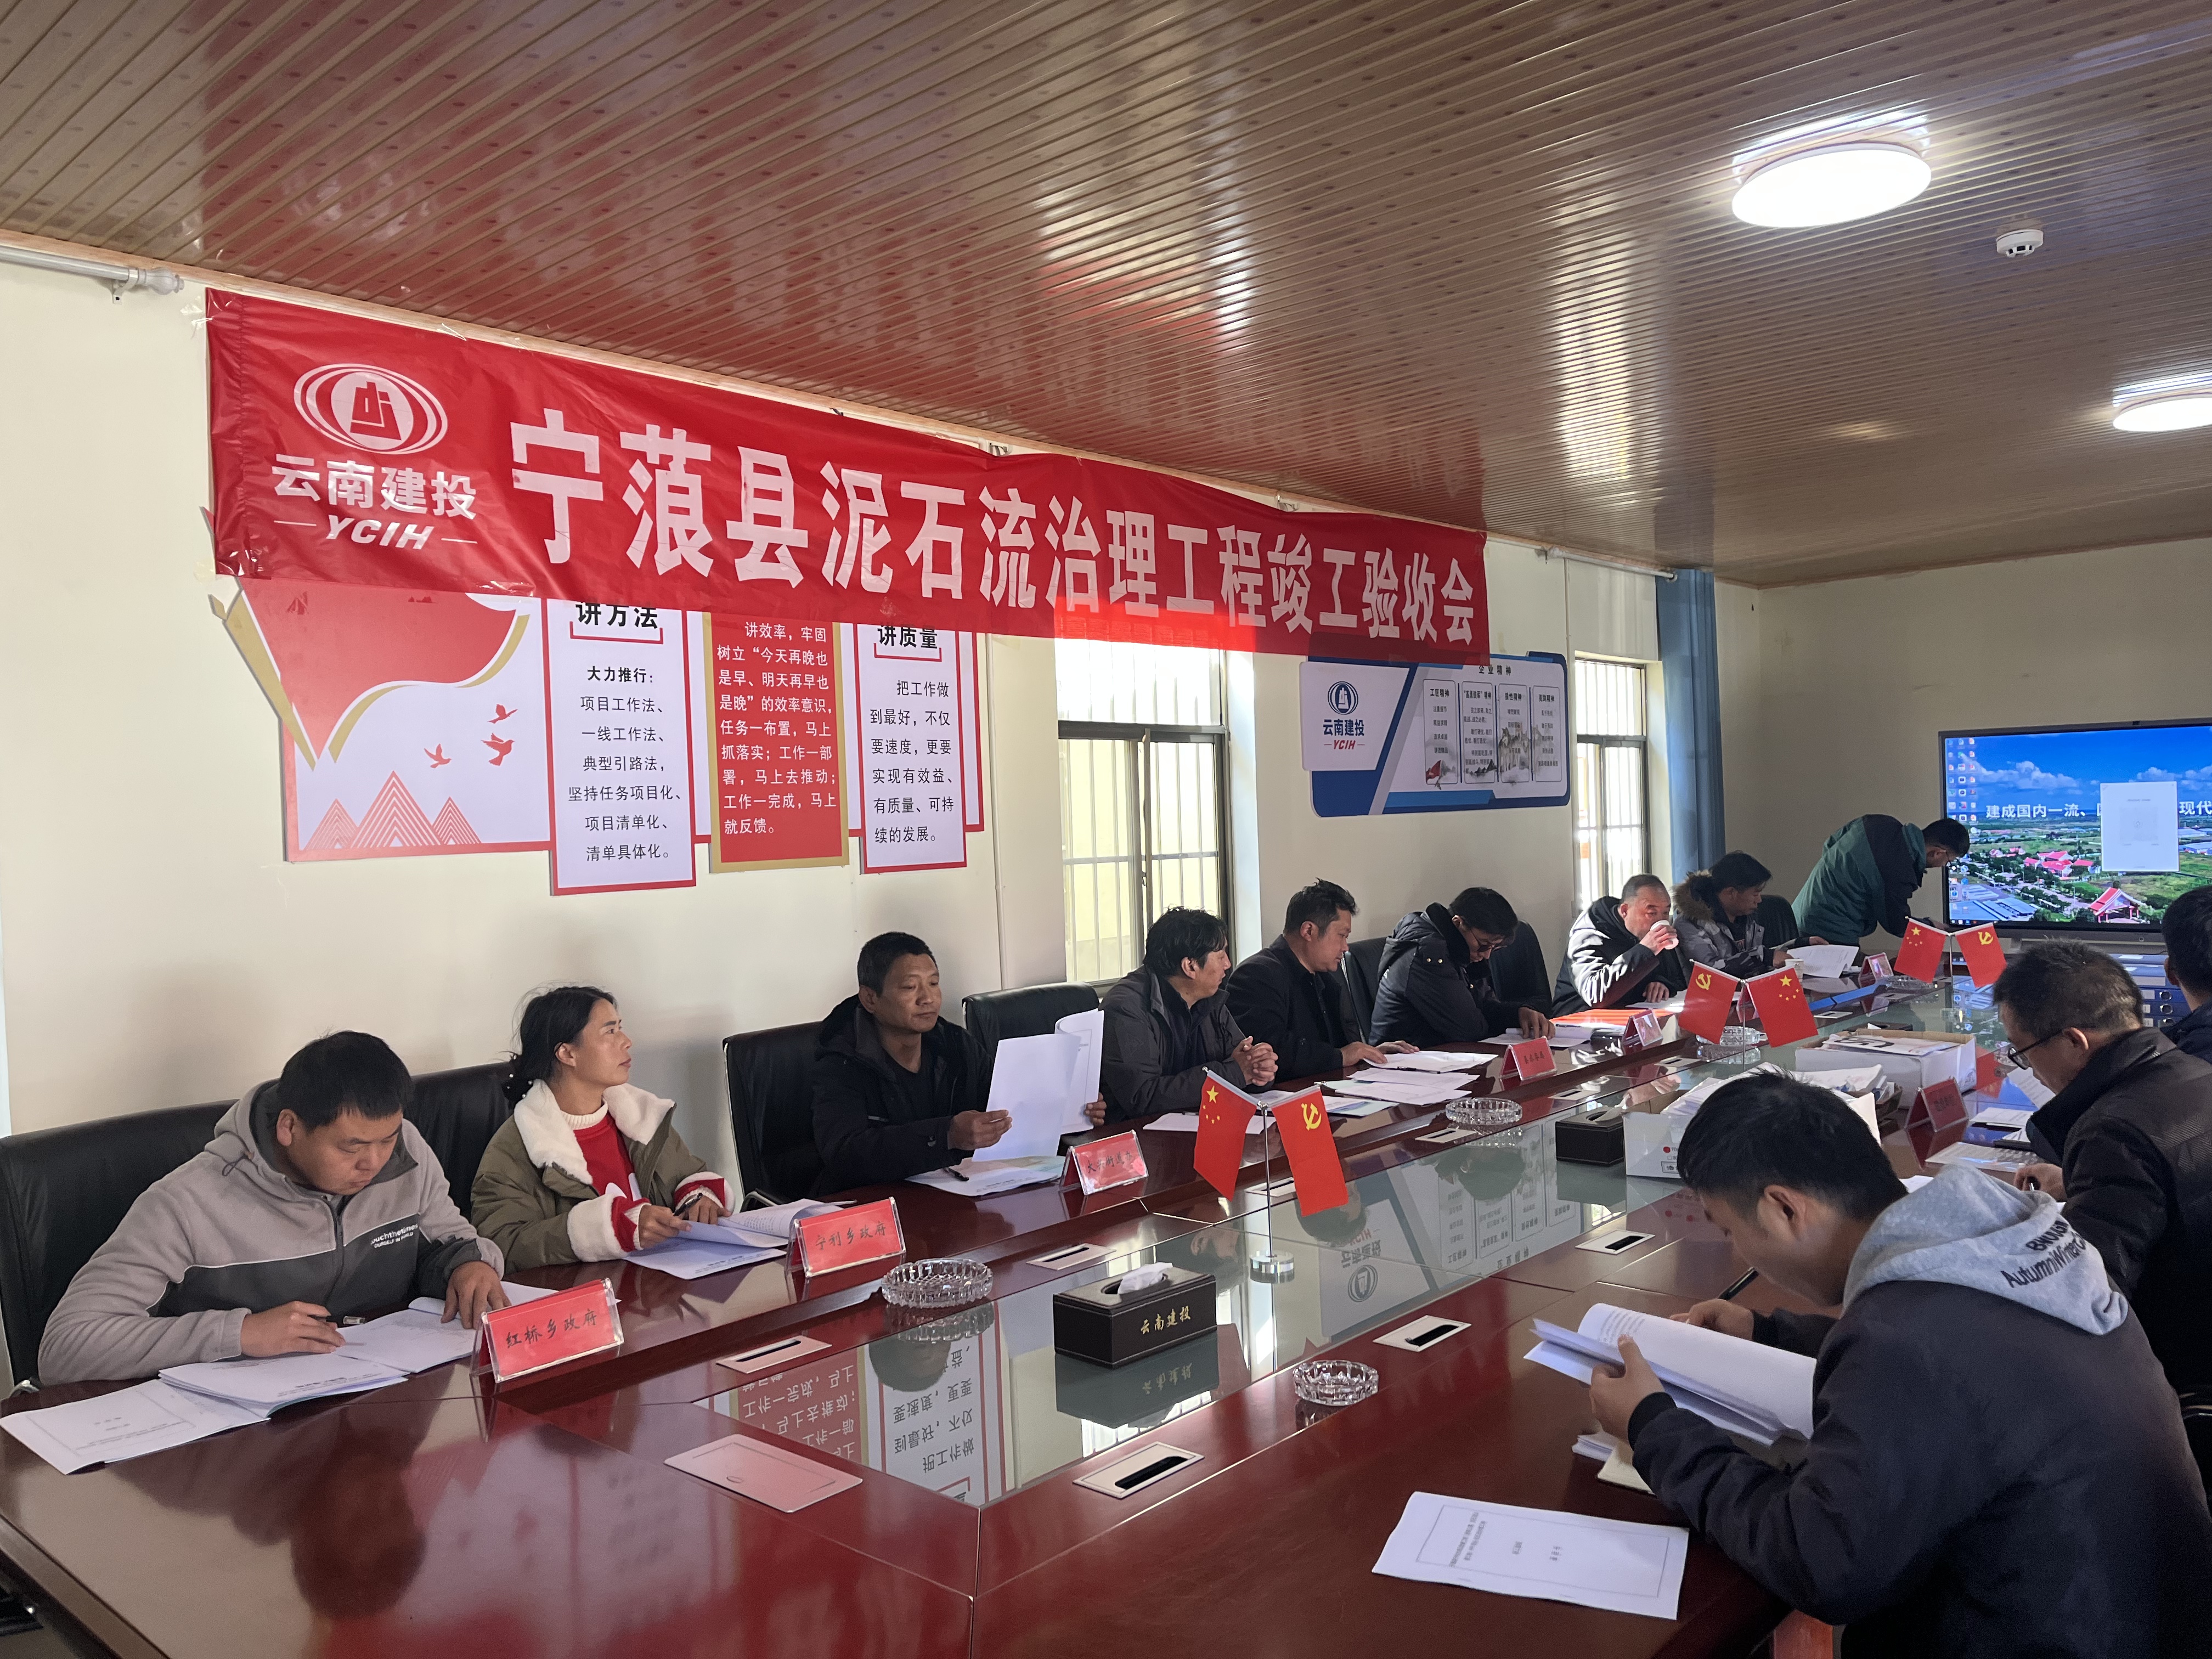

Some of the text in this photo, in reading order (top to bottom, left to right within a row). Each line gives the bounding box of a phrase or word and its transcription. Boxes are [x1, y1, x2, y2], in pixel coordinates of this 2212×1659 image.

[272, 453, 477, 520] 云南建投
[325, 514, 435, 550] YCIH
[510, 408, 1475, 646] 宁蒗县泥石流治理工程竣工验收会
[744, 622, 826, 643] 讲效率，牢固
[717, 644, 828, 666] 树立“今天再晚也
[587, 665, 653, 683] 大力推行：
[718, 669, 829, 690] 是早、明天再早也
[896, 680, 949, 698] 把工作做
[580, 696, 663, 713] 项目工作法、
[719, 694, 831, 714] 是晚”的效率意识，
[870, 709, 950, 726] 到最好，不仅
[582, 726, 663, 742] 一线工作法、
[720, 719, 831, 737] 任务一布置，马上
[1323, 719, 1365, 737] 云南建投
[721, 744, 832, 761] 抓落实；工作一部
[871, 738, 951, 755] 要速度，更要
[1333, 740, 1356, 751] YCIH
[723, 769, 835, 786] 署，马上去推动；
[873, 768, 952, 784] 实现有效益、
[568, 785, 681, 802] 坚持任务项目化、
[724, 792, 837, 809] 工作一完成，马上
[873, 796, 954, 814] 有质量、可持
[1986, 803, 2101, 819] 建成国内一流、
[585, 814, 668, 831] 项目清单化、
[724, 817, 774, 834] 就反馈。
[874, 826, 935, 843] 续的发展。
[586, 843, 668, 861] 清单具体化。
[816, 1221, 886, 1250] 宁利乡政府
[506, 1308, 597, 1349] 红桥乡政府
[1141, 1305, 1191, 1334] 云南建投
